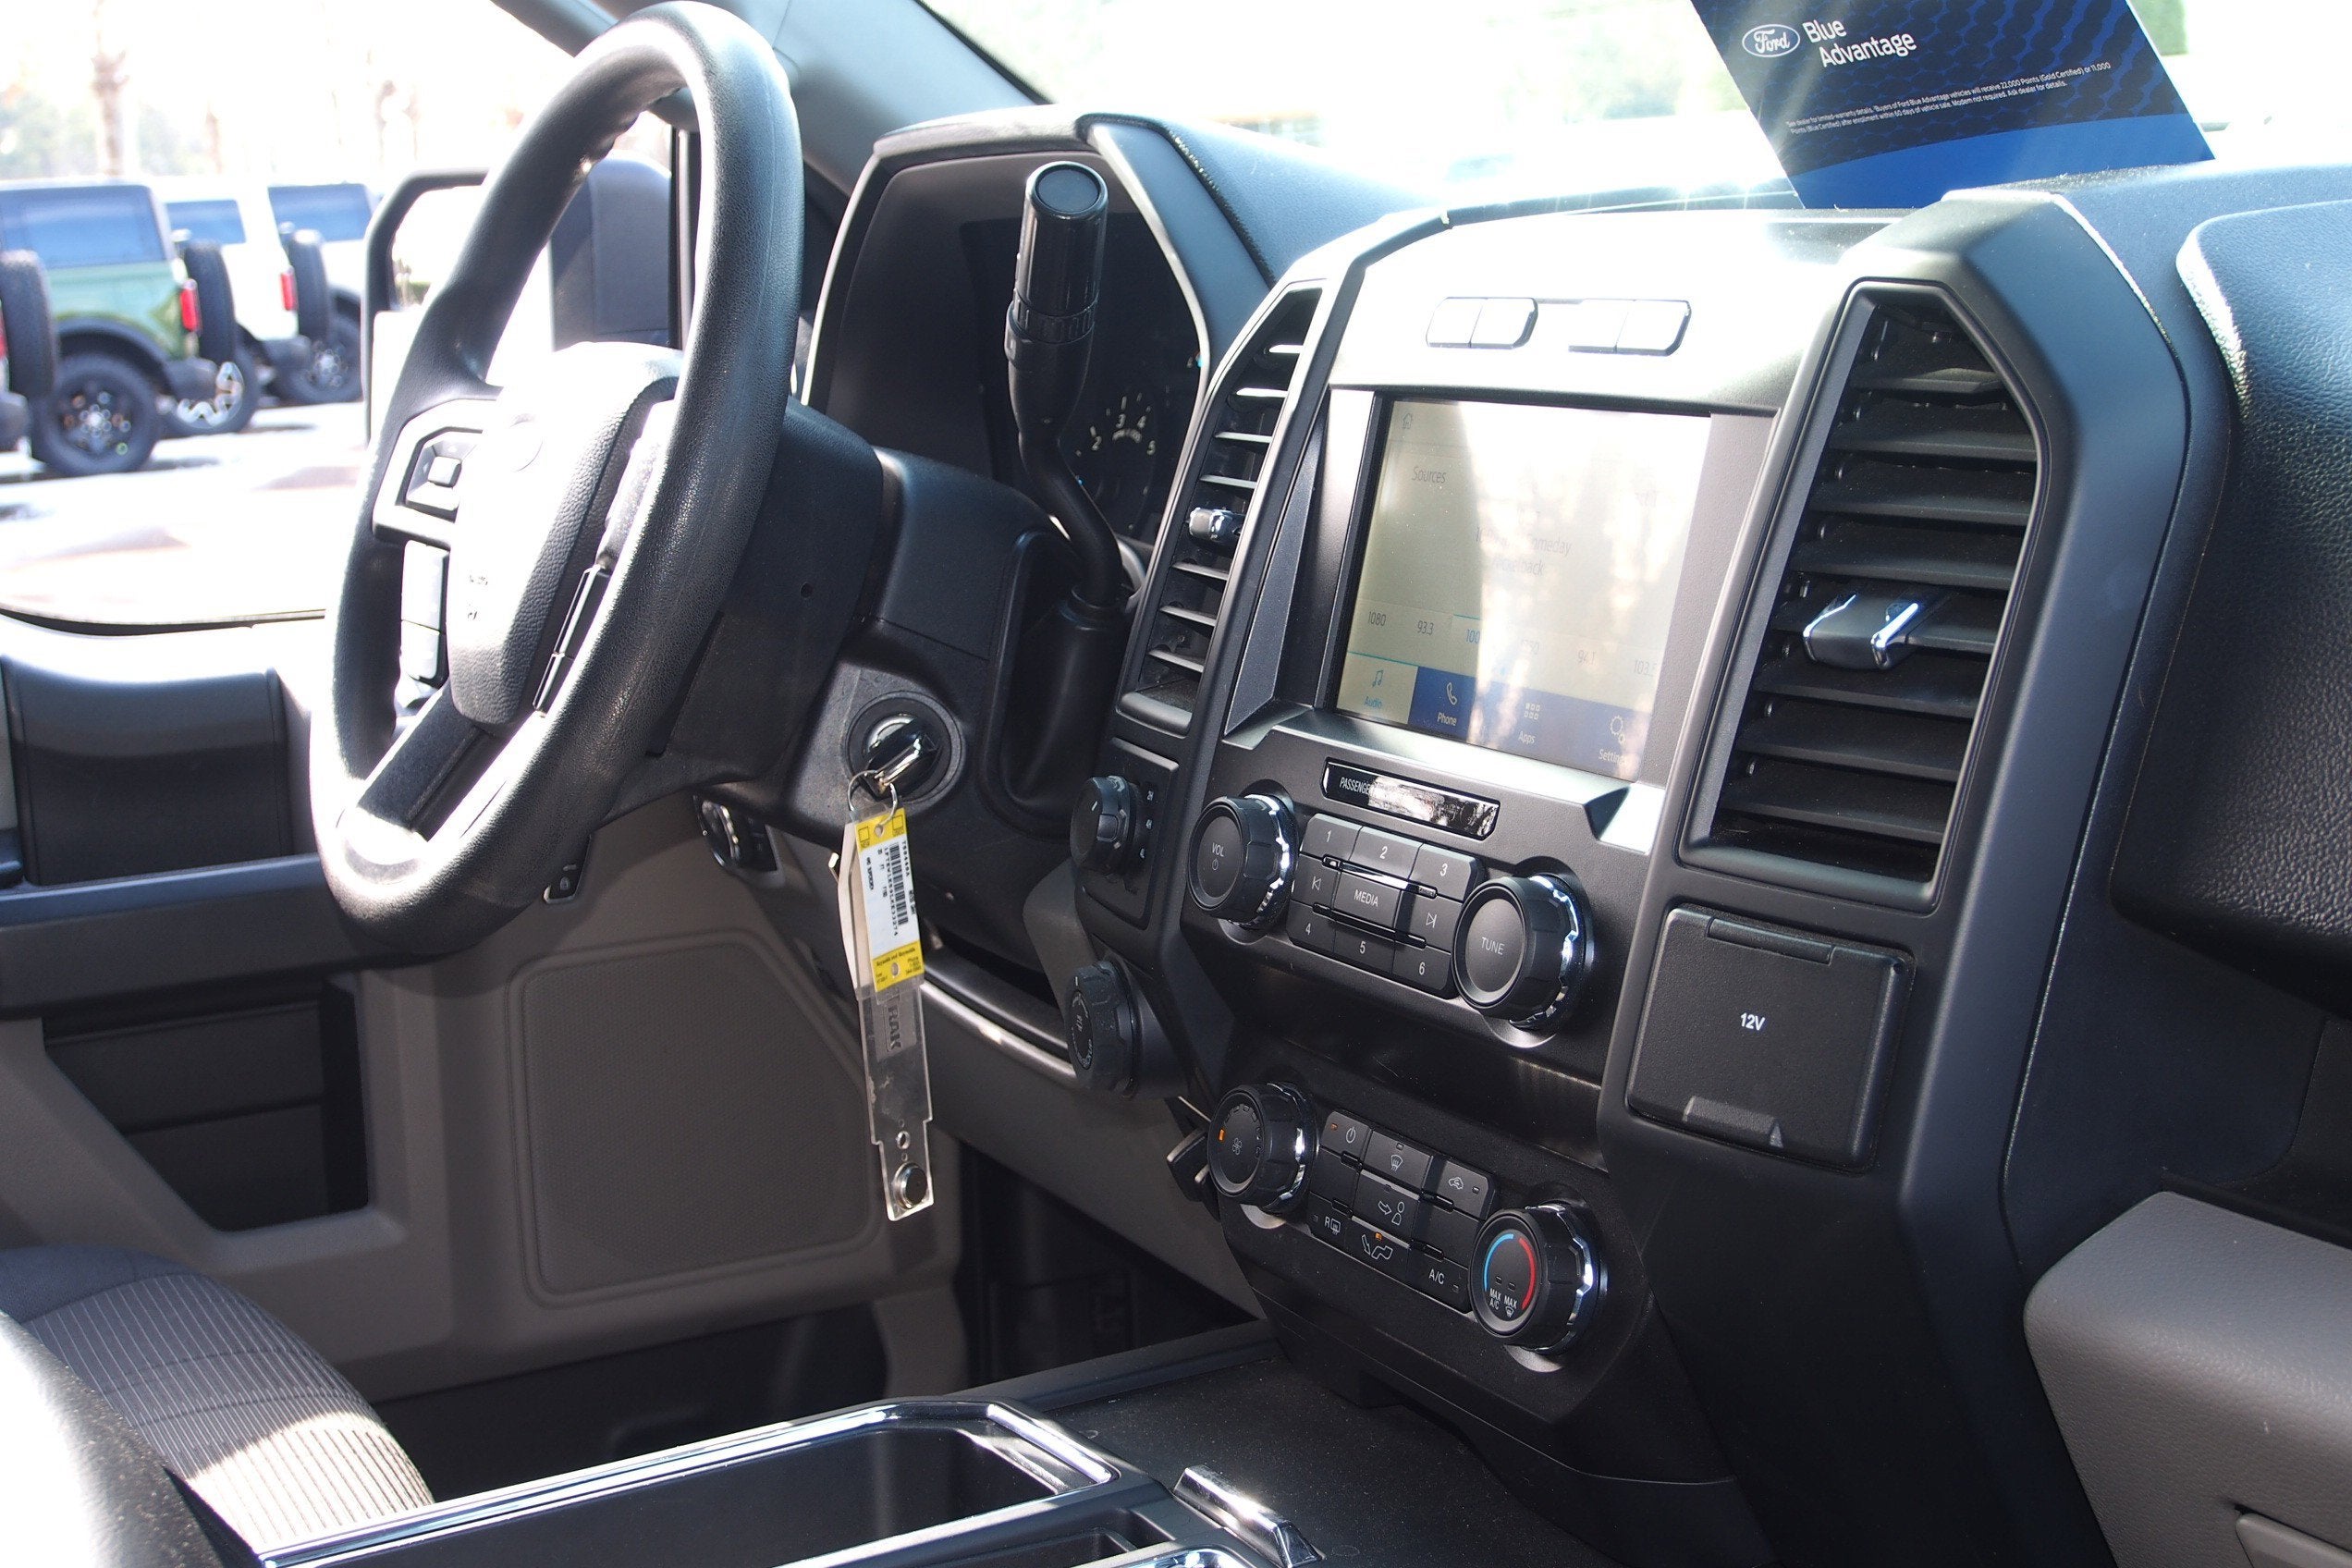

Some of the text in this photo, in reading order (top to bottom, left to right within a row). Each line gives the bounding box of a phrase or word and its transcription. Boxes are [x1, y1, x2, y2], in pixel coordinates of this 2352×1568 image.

[1802, 19, 1847, 43] Blue
[1754, 29, 1790, 54] Ford
[1819, 32, 1917, 67] Advantage
[1922, 93, 1950, 104] Advantage
[1950, 90, 1971, 98] vehicles
[1981, 84, 2001, 92] receive
[2021, 76, 2040, 85] Points
[2040, 73, 2056, 83] (Gold
[2056, 67, 2085, 79] Certified)
[1921, 104, 1940, 112] vehicle
[1983, 91, 2007, 101] required.
[2018, 85, 2036, 94] dealer
[2046, 80, 2067, 90] details.
[1116, 414, 1126, 428] 3
[1091, 435, 1102, 451] 2
[1412, 466, 1446, 484] Sources
[1368, 611, 1387, 627] 1080
[1417, 620, 1434, 636] 93.3
[1364, 695, 1382, 708] Audio
[1437, 712, 1457, 727] Phone
[1518, 730, 1536, 745] Apps
[1339, 777, 1372, 795] PASSENGE
[1326, 830, 1332, 842] 1
[1212, 842, 1225, 857] VOL
[1379, 846, 1388, 860] 2
[1439, 864, 1448, 876] 3
[1354, 888, 1378, 907] MEDIA
[1305, 923, 1312, 936] 4
[1359, 940, 1366, 954] 5
[1481, 936, 1505, 956] TUNE
[1418, 962, 1426, 975] 6
[1740, 1012, 1766, 1032] 12V
[1428, 1268, 1445, 1285] A/C
[1489, 1288, 1501, 1301] MAX
[1503, 1294, 1517, 1309] MAX
[1489, 1298, 1500, 1310] A/C
